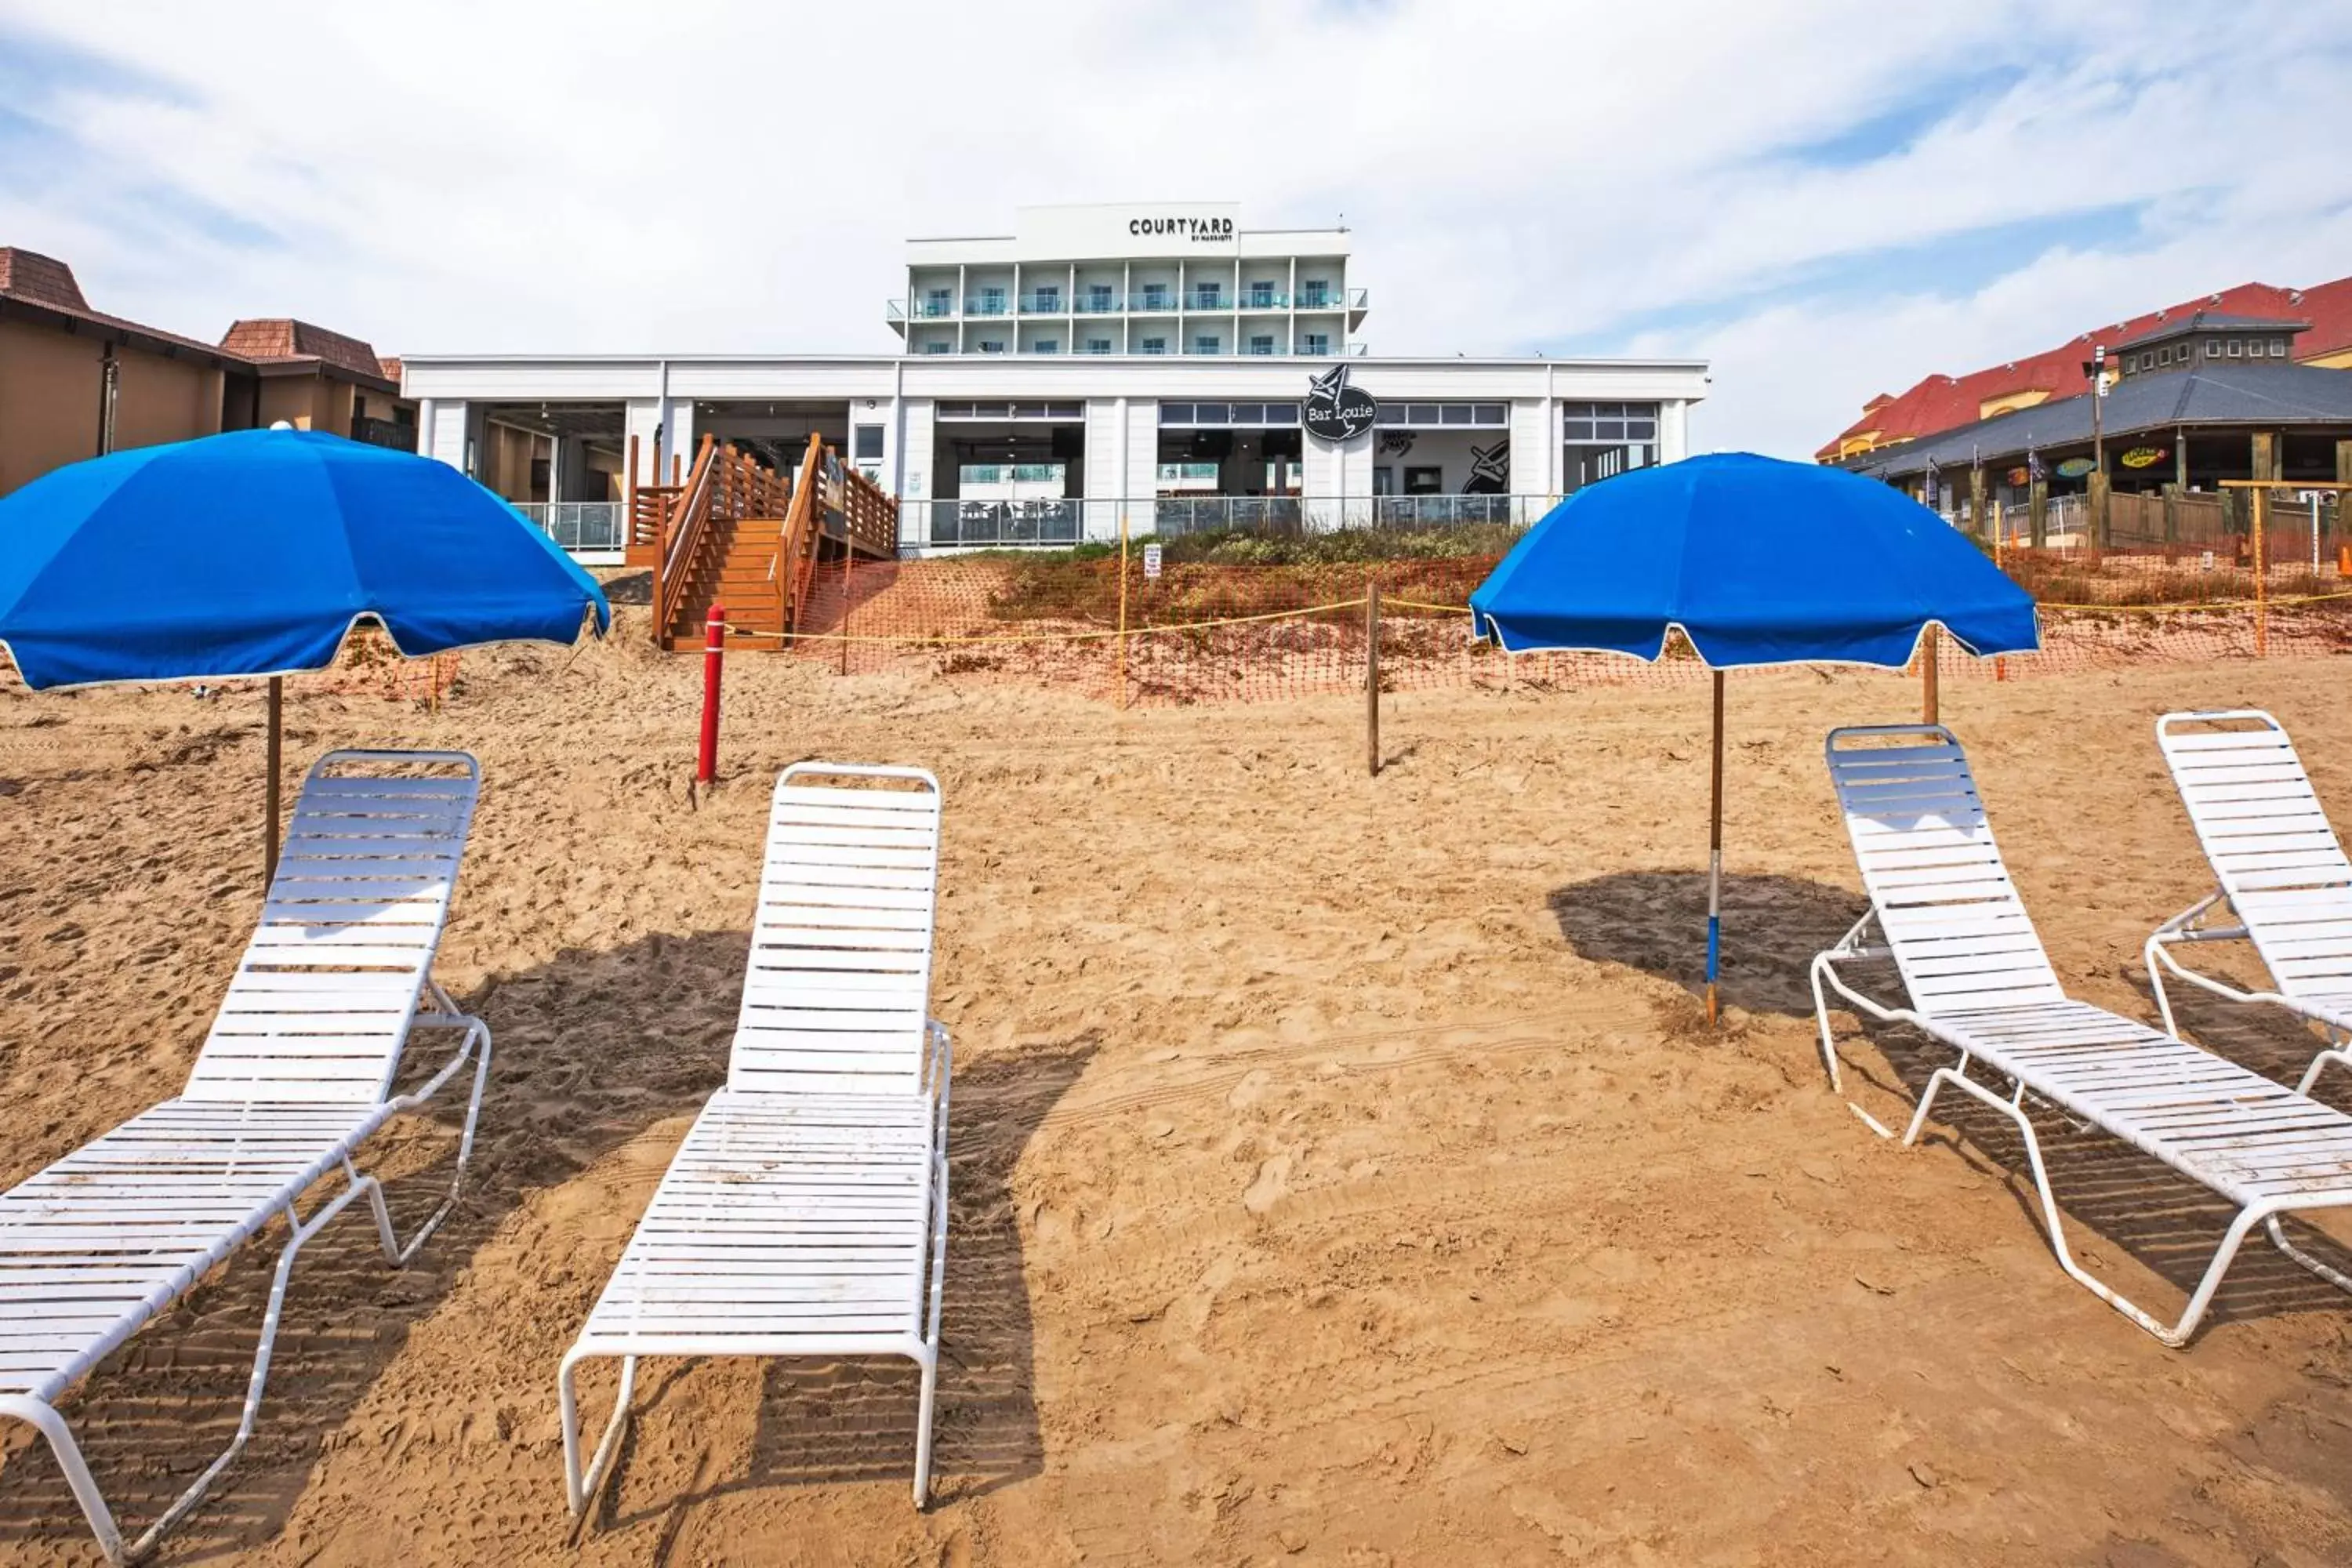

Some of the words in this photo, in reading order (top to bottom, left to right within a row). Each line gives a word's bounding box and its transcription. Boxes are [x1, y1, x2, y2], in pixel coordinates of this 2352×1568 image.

[1129, 218, 1233, 235] COURTYARD
[1308, 407, 1332, 422] Bar
[1335, 404, 1374, 419] Louie
